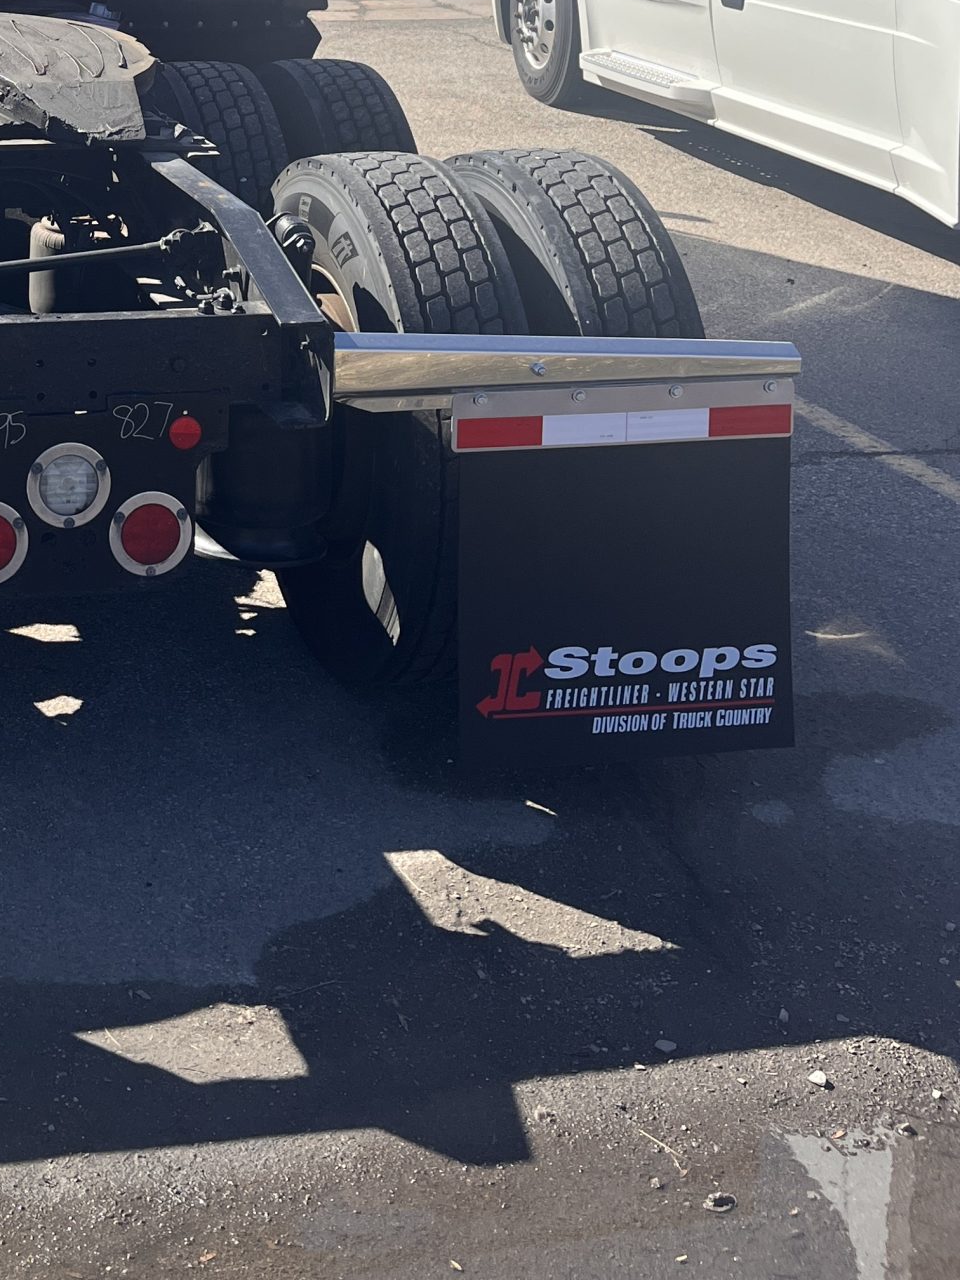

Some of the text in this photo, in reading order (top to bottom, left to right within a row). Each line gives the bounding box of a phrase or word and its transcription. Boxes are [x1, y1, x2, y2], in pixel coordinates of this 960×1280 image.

[112, 401, 174, 440] 827
[543, 643, 778, 680] Stoops
[545, 683, 650, 710] FREIGHTLINER
[668, 679, 733, 703] WESTERN
[739, 677, 775, 699] STAR
[592, 707, 772, 734] DIVISION OF TRUCK COUNTRY
